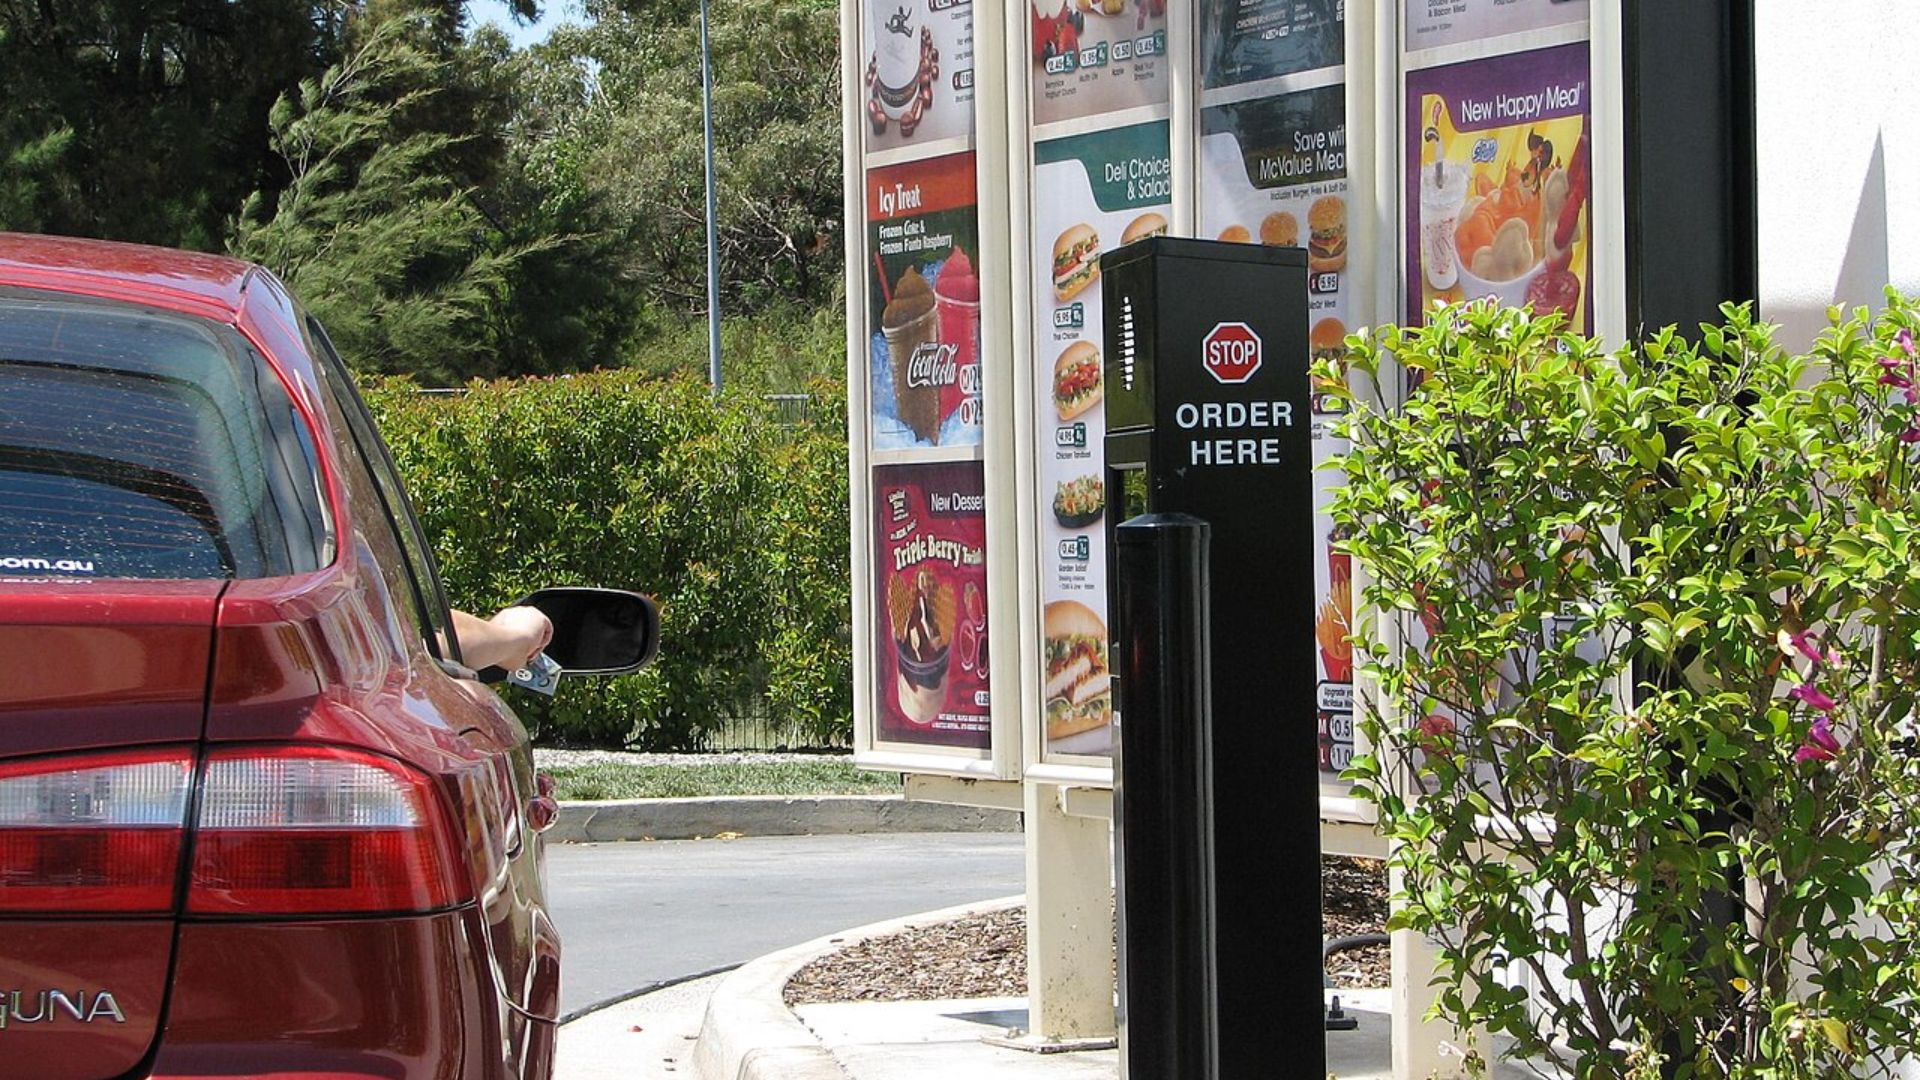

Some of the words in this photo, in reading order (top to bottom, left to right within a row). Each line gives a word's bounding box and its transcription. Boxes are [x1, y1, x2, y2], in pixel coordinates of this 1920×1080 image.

[1462, 100, 1492, 123] New
[1496, 92, 1543, 120] Happy
[1294, 131, 1325, 152] Save
[1105, 161, 1126, 182] Deli
[1129, 156, 1169, 179] Choice
[1260, 154, 1312, 180] McValue
[879, 186, 894, 217] Icy
[895, 183, 921, 210] Treat
[1128, 180, 1136, 200] &
[879, 225, 903, 239] Frozen
[880, 242, 903, 255] Frozen
[904, 239, 921, 252] Fanta
[923, 233, 952, 250] Raspberry
[1210, 340, 1256, 365] STOP
[1175, 401, 1293, 429] ORDER
[1191, 438, 1280, 466] HERE
[931, 493, 950, 511] New
[0, 557, 94, 571] om.au
[893, 534, 927, 570] Triple
[927, 534, 961, 568] Berry
[1319, 719, 1327, 734] M
[1320, 748, 1325, 764] L
[0, 989, 126, 1028] UNA
